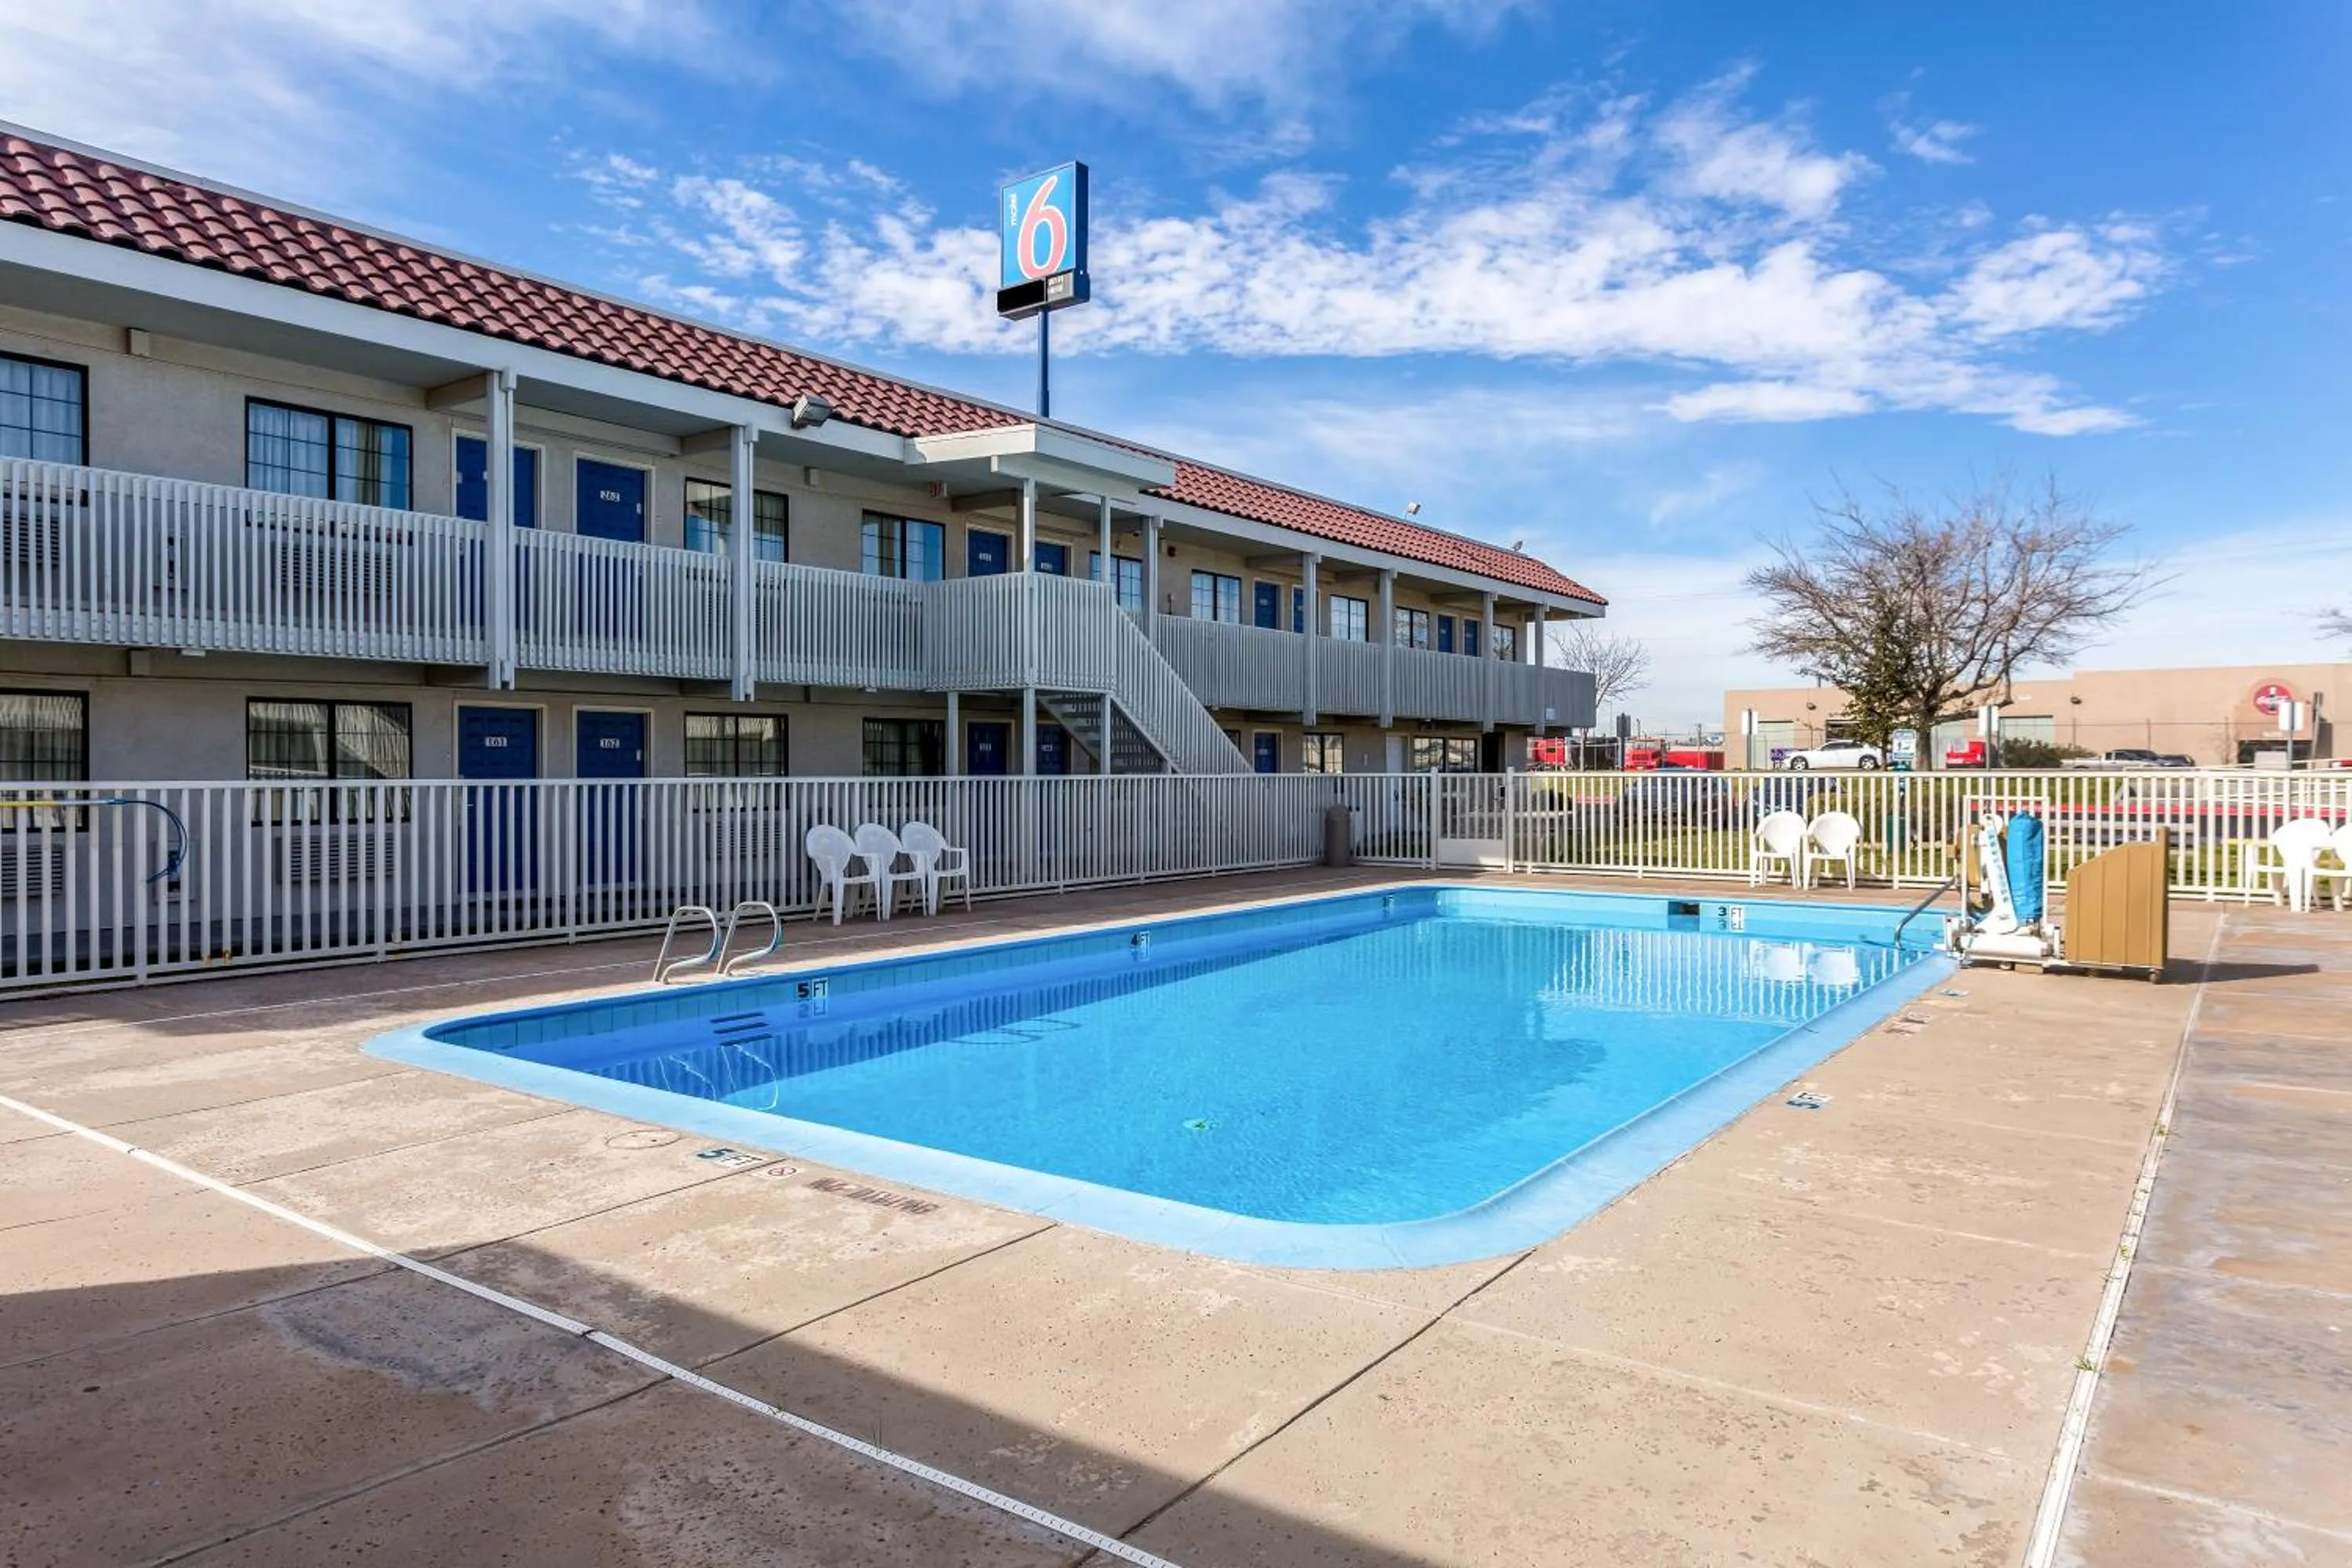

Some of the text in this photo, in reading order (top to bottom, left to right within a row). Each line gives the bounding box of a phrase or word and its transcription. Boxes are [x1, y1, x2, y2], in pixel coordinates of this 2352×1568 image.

[1018, 175, 1067, 280] 6
[1718, 906, 1744, 918] 3 FT
[797, 979, 827, 998] 5 FT
